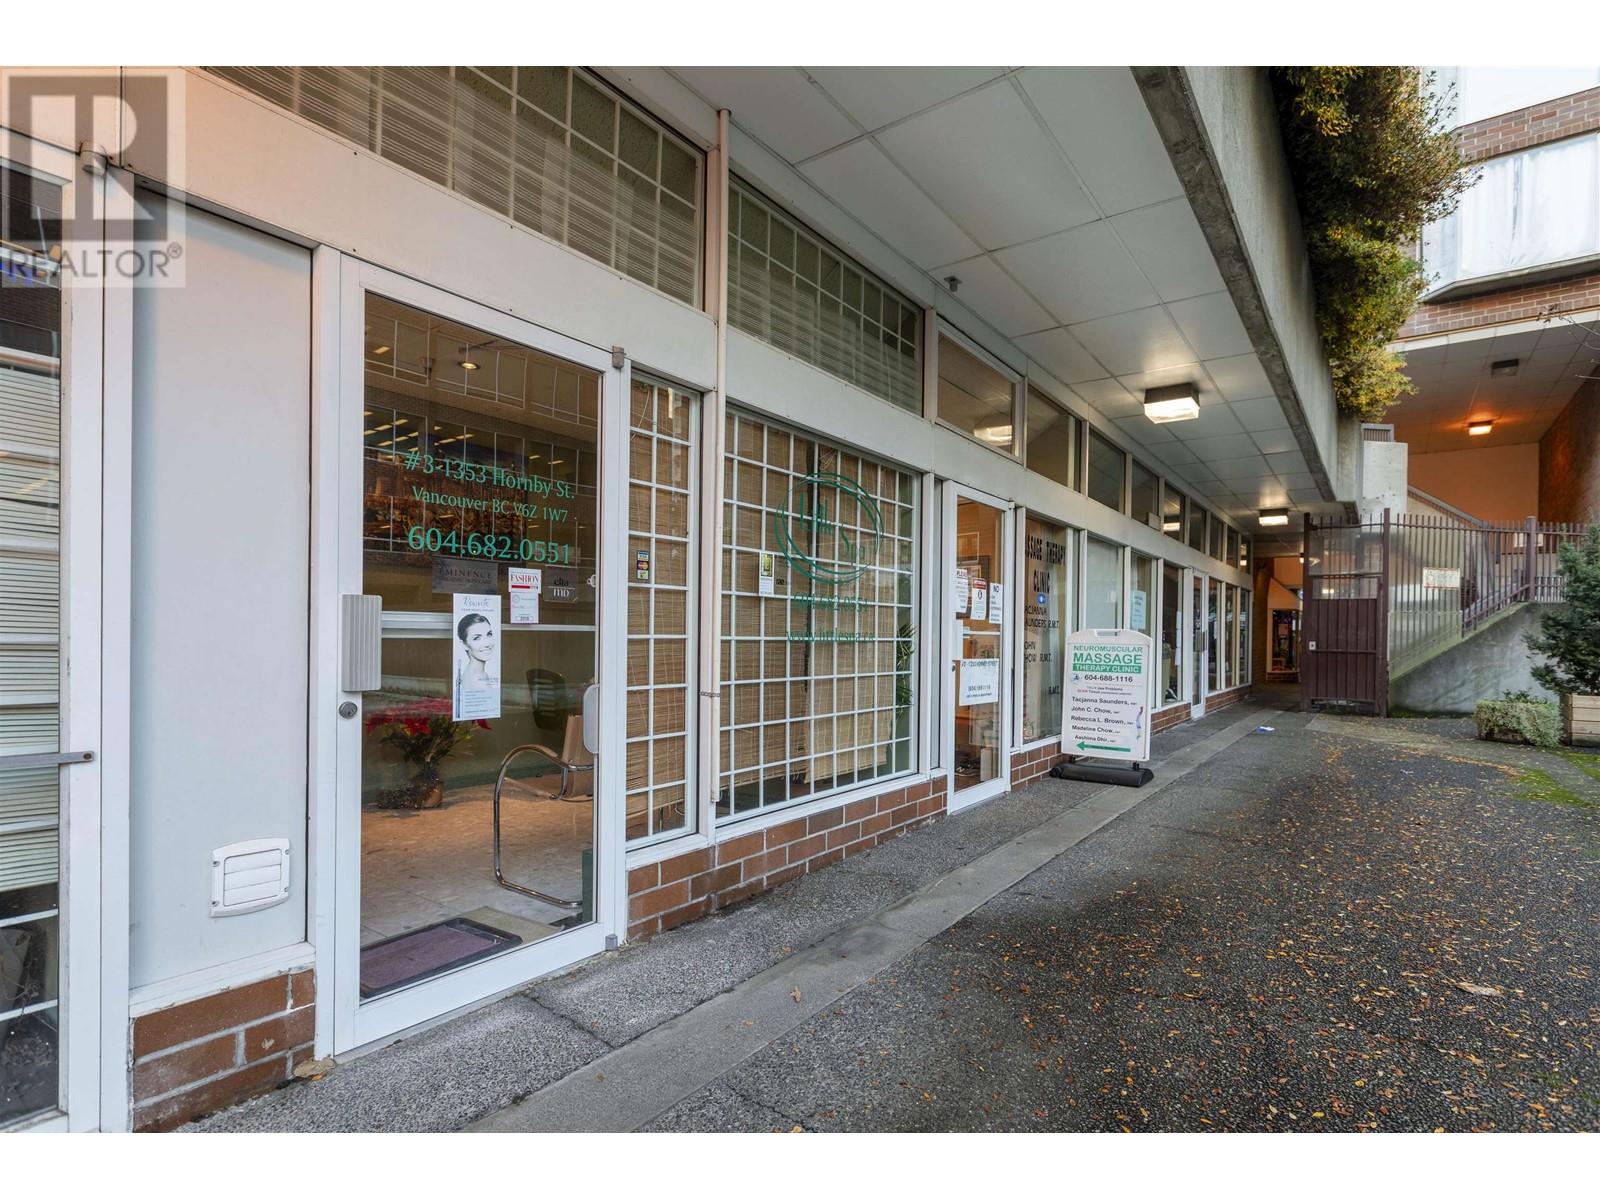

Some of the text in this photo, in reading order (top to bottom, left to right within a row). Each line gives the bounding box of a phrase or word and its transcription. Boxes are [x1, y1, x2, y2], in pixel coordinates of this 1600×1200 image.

[404, 450, 575, 499] #3-1353 Hornby St.
[412, 485, 568, 523] Vancouver BC V6Z 1W7
[407, 525, 570, 564] 604.682.0551
[1025, 534, 1066, 567] SSAGE THERAPY
[510, 573, 539, 583] FASHION
[1033, 569, 1050, 594] CLINIC
[1073, 645, 1143, 653] NEUROMUSCULAR
[1073, 652, 1143, 665] MASSAGE
[1075, 663, 1140, 673] THERAPY CLINIC
[1084, 674, 1133, 683] 604-688-1116
[1099, 698, 1130, 706] Saunders,
